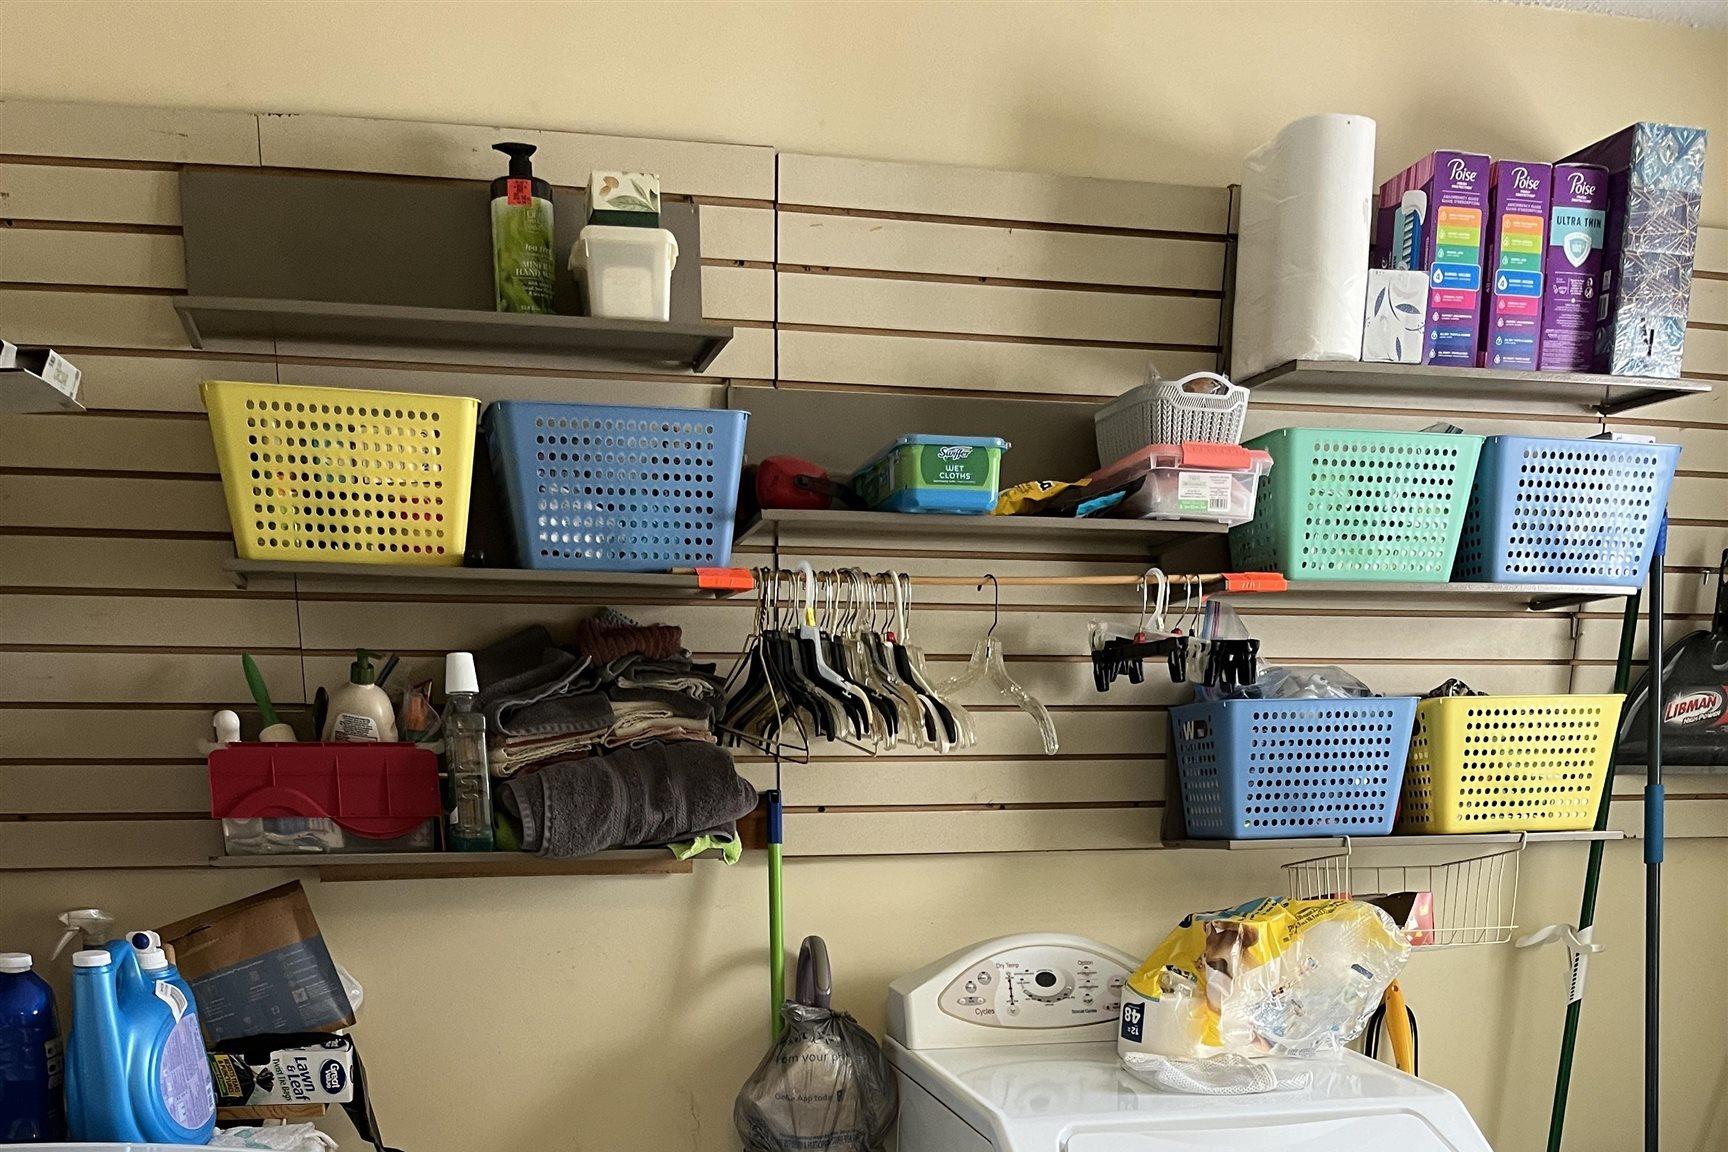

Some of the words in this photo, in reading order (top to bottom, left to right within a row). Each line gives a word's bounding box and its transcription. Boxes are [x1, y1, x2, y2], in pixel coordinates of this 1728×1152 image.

[1447, 158, 1477, 182] Poise
[1511, 167, 1541, 190] Poise
[1567, 172, 1597, 196] Poise
[1556, 215, 1582, 226] ULTRA
[1584, 216, 1602, 229] THIN
[938, 446, 972, 461] Swiffer
[939, 472, 971, 480] CLOTHS
[945, 464, 965, 472] WET
[1665, 694, 1717, 721] LIBMAN
[974, 1007, 996, 1017] Cycles
[1124, 1006, 1141, 1024] 48
[802, 1053, 827, 1063] your
[272, 1058, 284, 1076] Twist
[281, 1086, 292, 1101] Bags
[293, 1056, 315, 1092] Lawn
[330, 1063, 341, 1088] Great
[287, 1074, 311, 1101] Leaf
